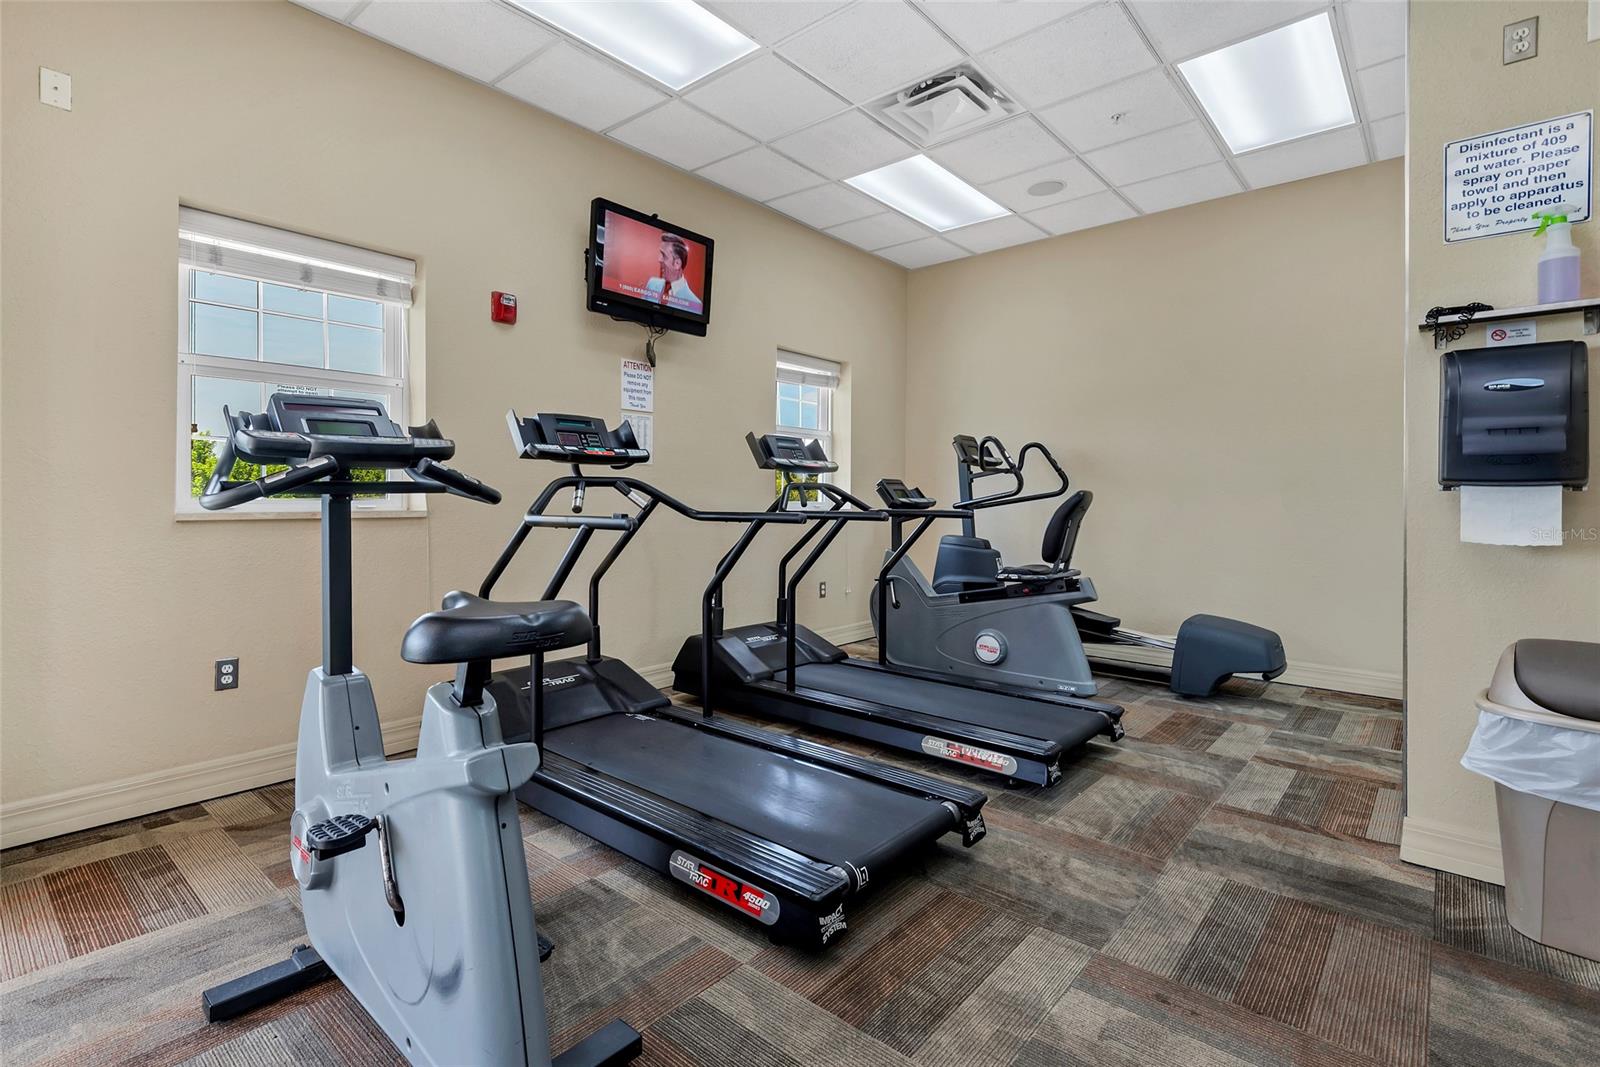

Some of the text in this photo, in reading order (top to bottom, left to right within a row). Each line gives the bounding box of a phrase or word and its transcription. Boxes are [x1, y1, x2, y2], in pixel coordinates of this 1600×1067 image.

[1459, 128, 1543, 153] Disinfectant
[1548, 124, 1561, 134] is
[1465, 134, 1567, 163] mixture of 409
[1454, 144, 1580, 176] and water. Please
[1462, 158, 1571, 187] spray on paper
[1451, 180, 1584, 212] apply to apparatus
[1462, 171, 1566, 197] towel and then
[1466, 210, 1480, 219] to
[1484, 206, 1501, 216] be
[1504, 194, 1566, 213] cleaned.
[1450, 216, 1529, 233] Thank You Property
[623, 361, 652, 372] ATTENTION
[676, 855, 695, 872] STAR
[689, 870, 709, 887] TRAC
[742, 891, 771, 910] 4500
[818, 902, 843, 925] IMPACT
[822, 921, 847, 944] SYSTEM
